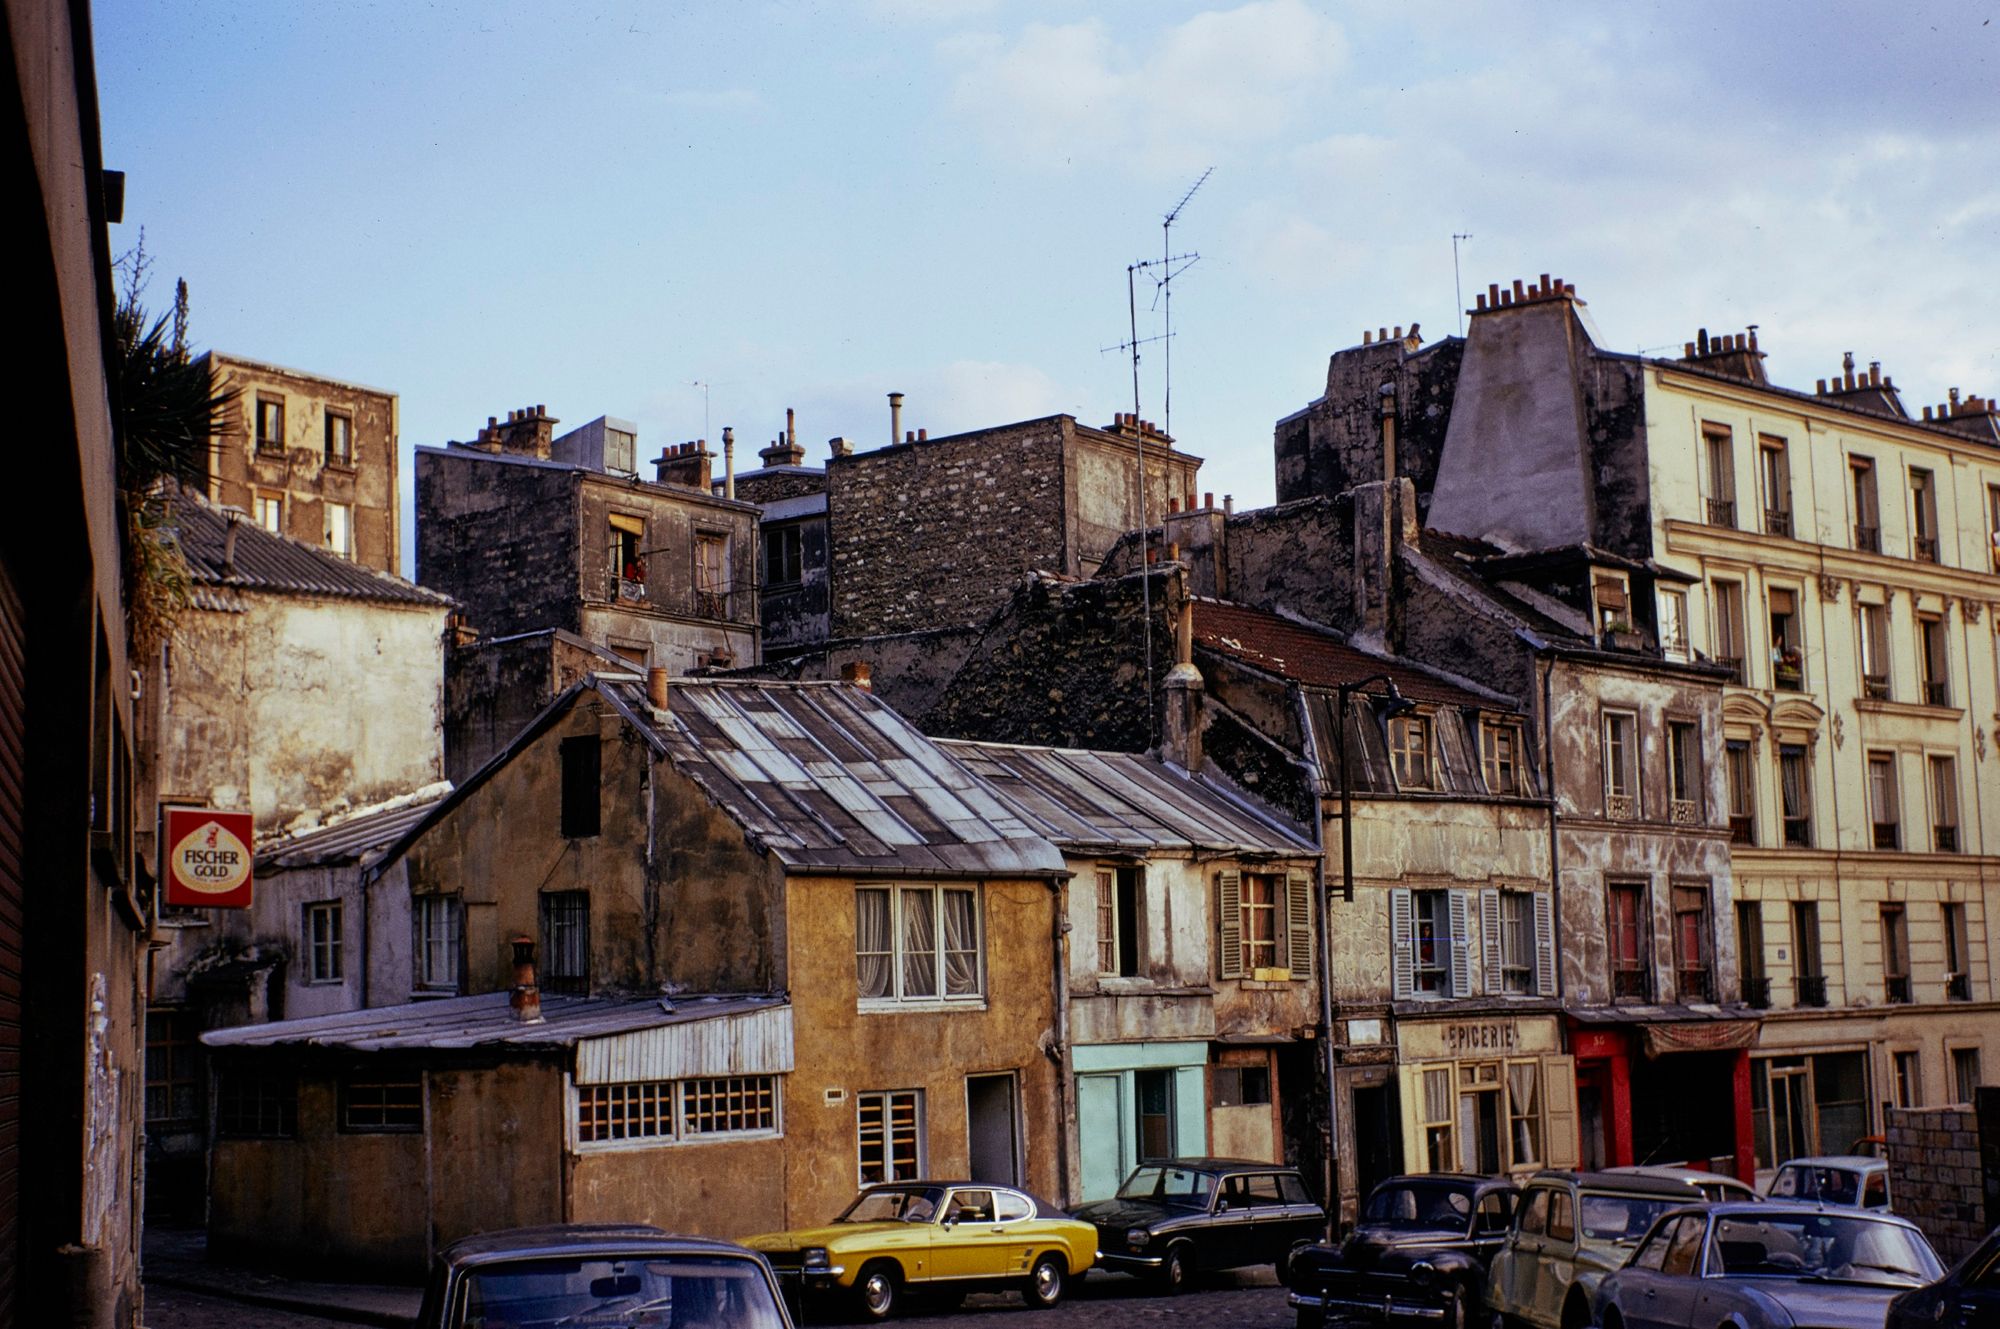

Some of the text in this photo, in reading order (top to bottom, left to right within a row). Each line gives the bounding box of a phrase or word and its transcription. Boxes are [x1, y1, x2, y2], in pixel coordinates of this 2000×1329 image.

[185, 849, 239, 864] FISCHER
[194, 865, 228, 877] GOLD
[1449, 1024, 1513, 1048] EPICERIE
